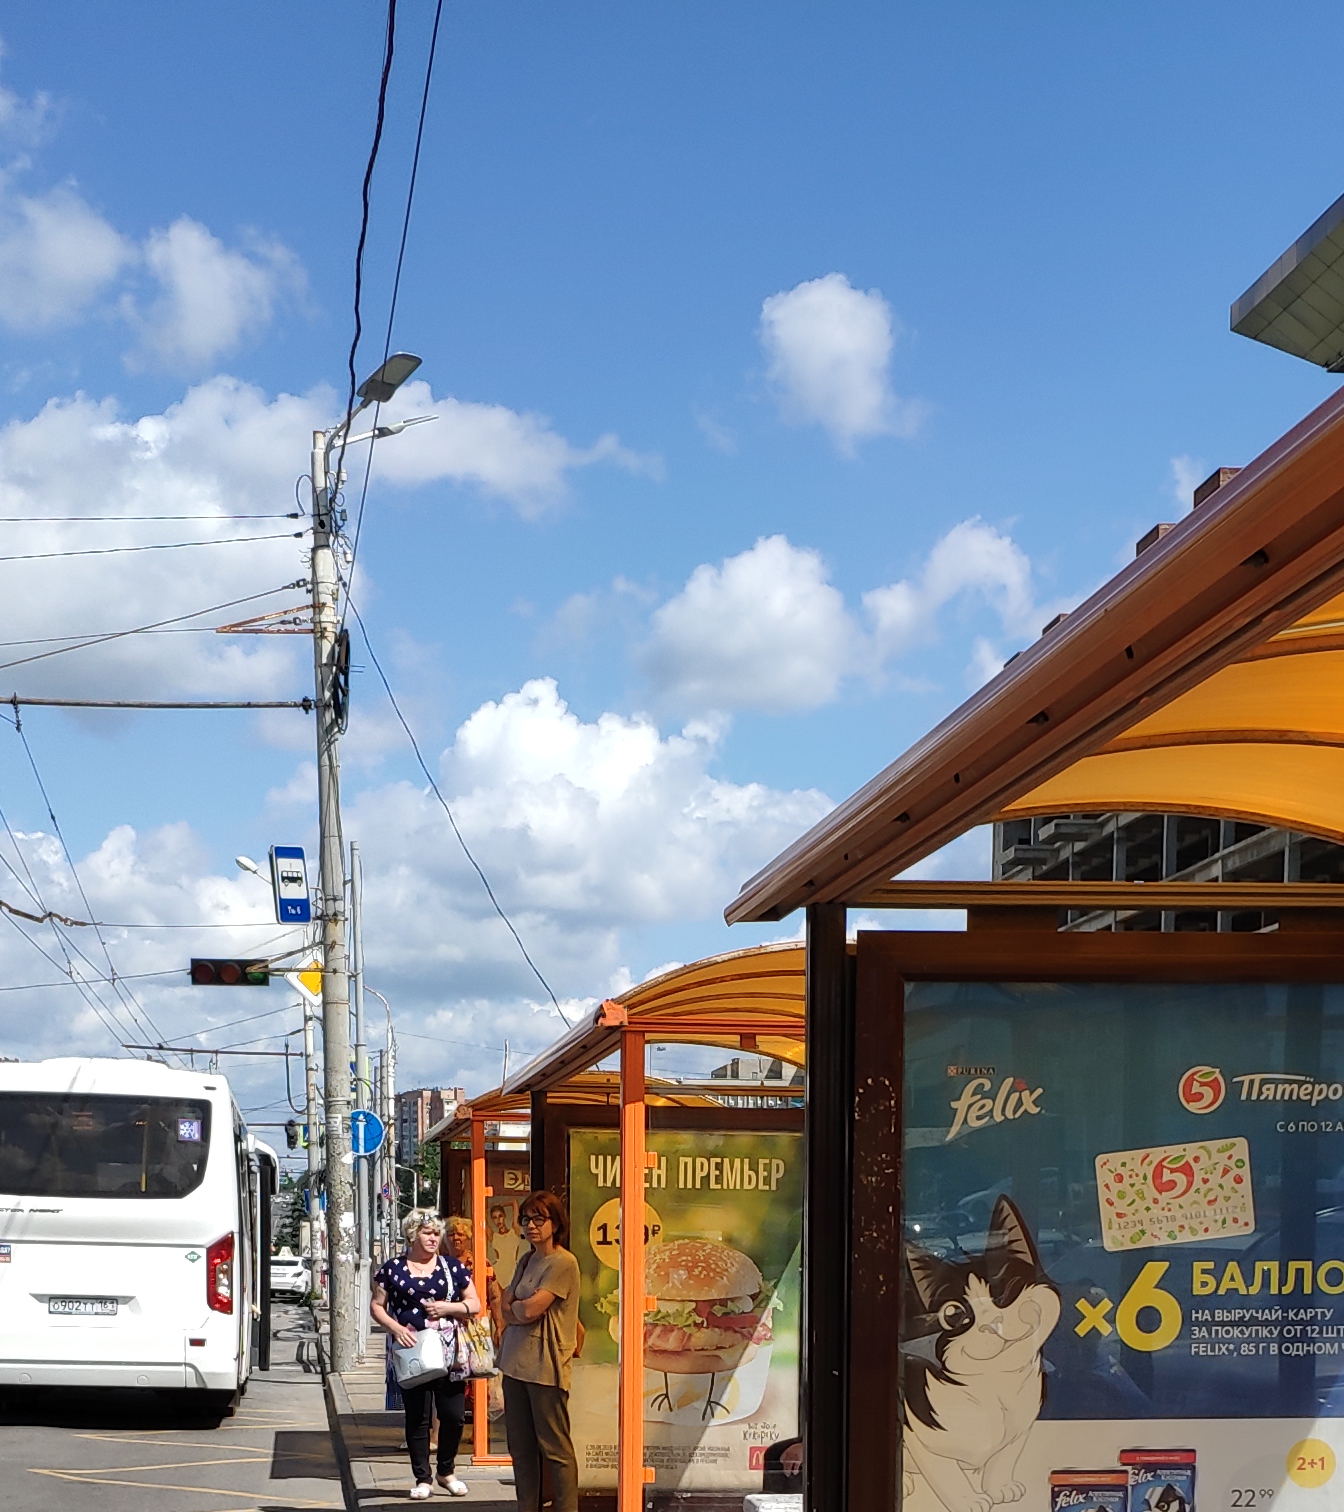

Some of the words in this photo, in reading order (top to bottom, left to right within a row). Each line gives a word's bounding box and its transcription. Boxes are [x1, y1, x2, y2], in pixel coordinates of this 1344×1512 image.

[958, 1067, 995, 1075] PURINA
[945, 1077, 1043, 1141] felix
[1276, 1121, 1285, 1132] С
[1288, 1121, 1295, 1132] 6
[1299, 1121, 1318, 1132] ПО
[1320, 1121, 1333, 1132] 12
[590, 1155, 667, 1188] ЧИН
[679, 1157, 785, 1191] ПРЕМЬЕР
[1116, 1219, 1144, 1230] 1234
[1191, 1310, 1211, 1321] НА
[1214, 1306, 1334, 1321] ВЫРУЧАЙ-КАРТУ
[1191, 1327, 1209, 1338] ЗА
[1212, 1326, 1280, 1338] ПОКУПКУ
[1283, 1326, 1302, 1337] ОТ
[1306, 1326, 1320, 1337] 12
[1241, 1343, 1256, 1354] 85
[1259, 1343, 1267, 1354] Г
[1270, 1343, 1278, 1354] В
[1281, 1343, 1340, 1355] ОДНОМ
[1297, 1456, 1325, 1471] 2+1
[1231, 1489, 1256, 1507] 22
[1259, 1489, 1274, 1498] 99
